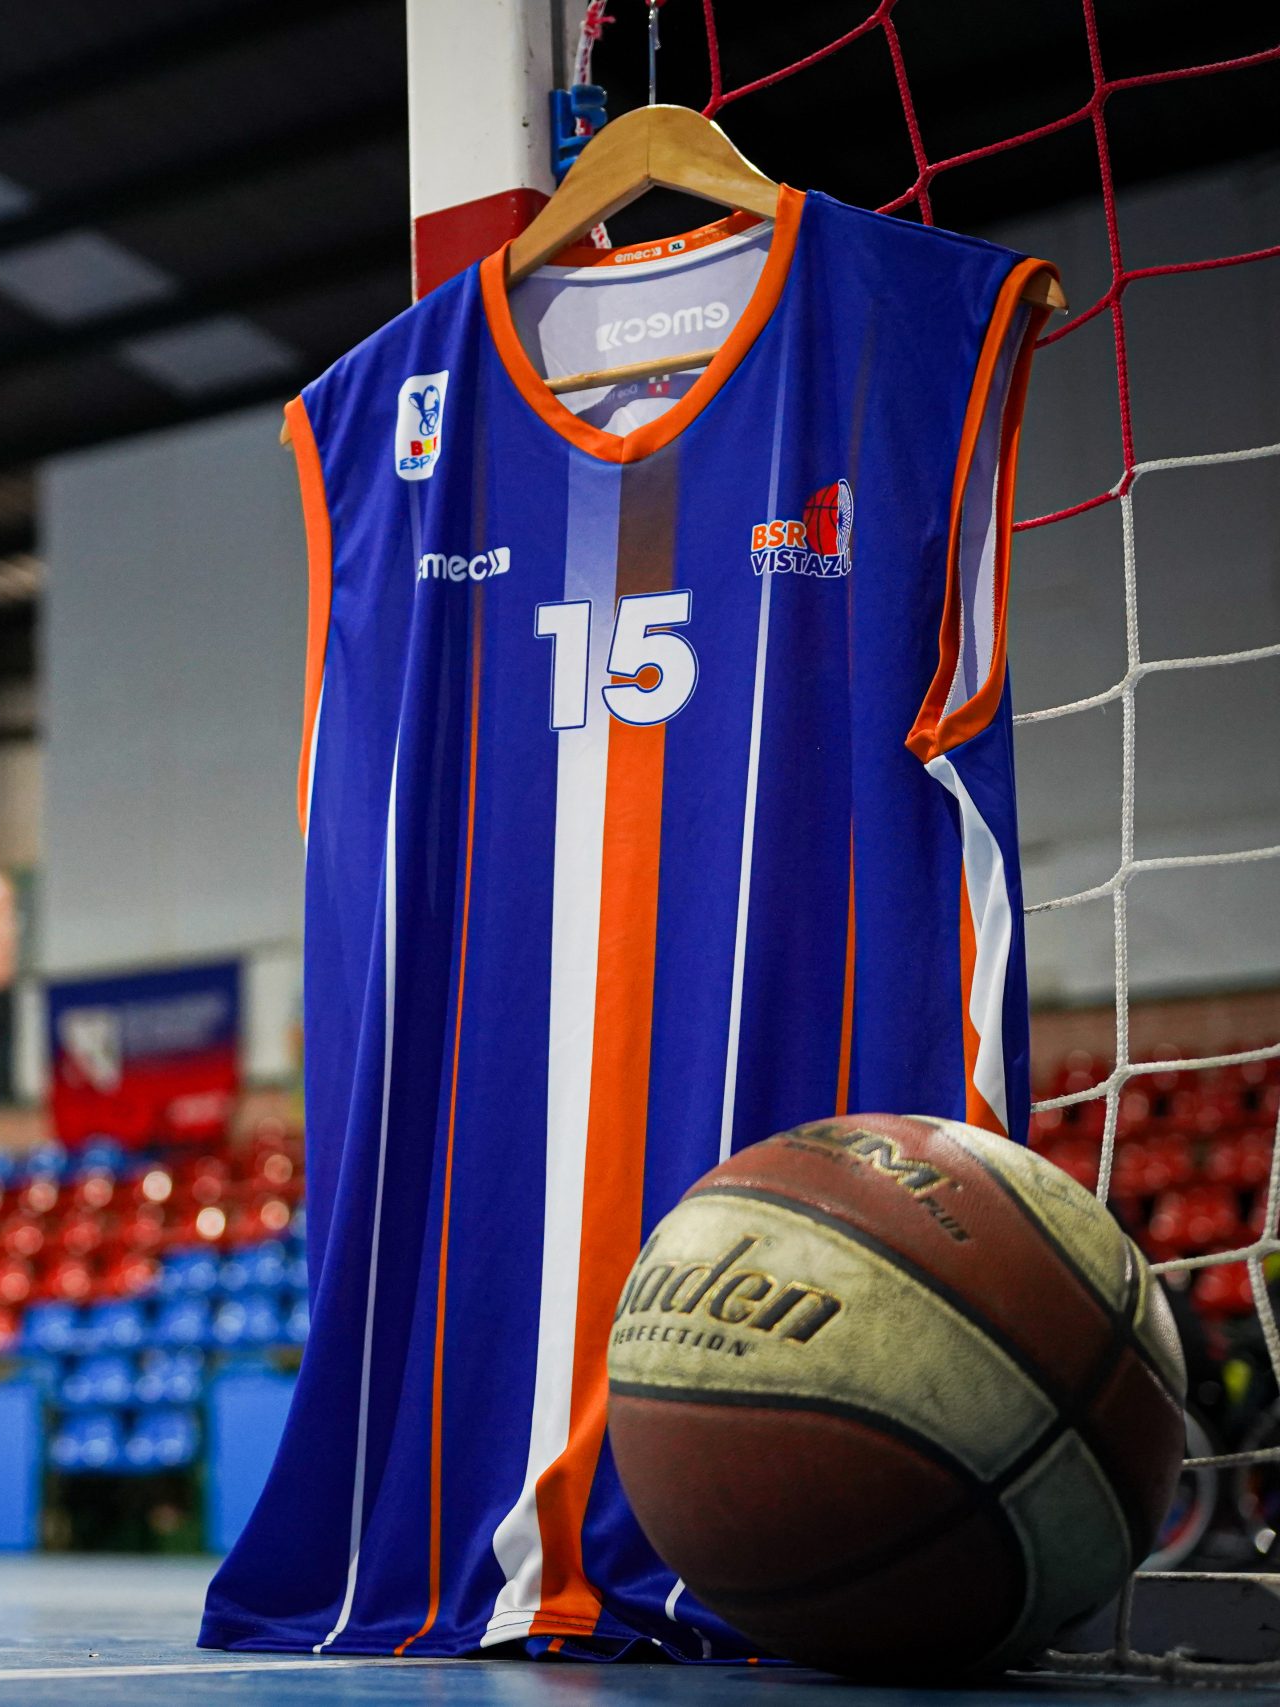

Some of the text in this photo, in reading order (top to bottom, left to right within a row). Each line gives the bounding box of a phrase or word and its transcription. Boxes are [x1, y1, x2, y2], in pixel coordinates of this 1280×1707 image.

[614, 248, 651, 264] emec
[671, 242, 682, 251] XL
[399, 455, 434, 471] ESP
[751, 520, 807, 552] BSR
[535, 588, 699, 732] 15
[613, 1325, 747, 1357] PERFECTION
